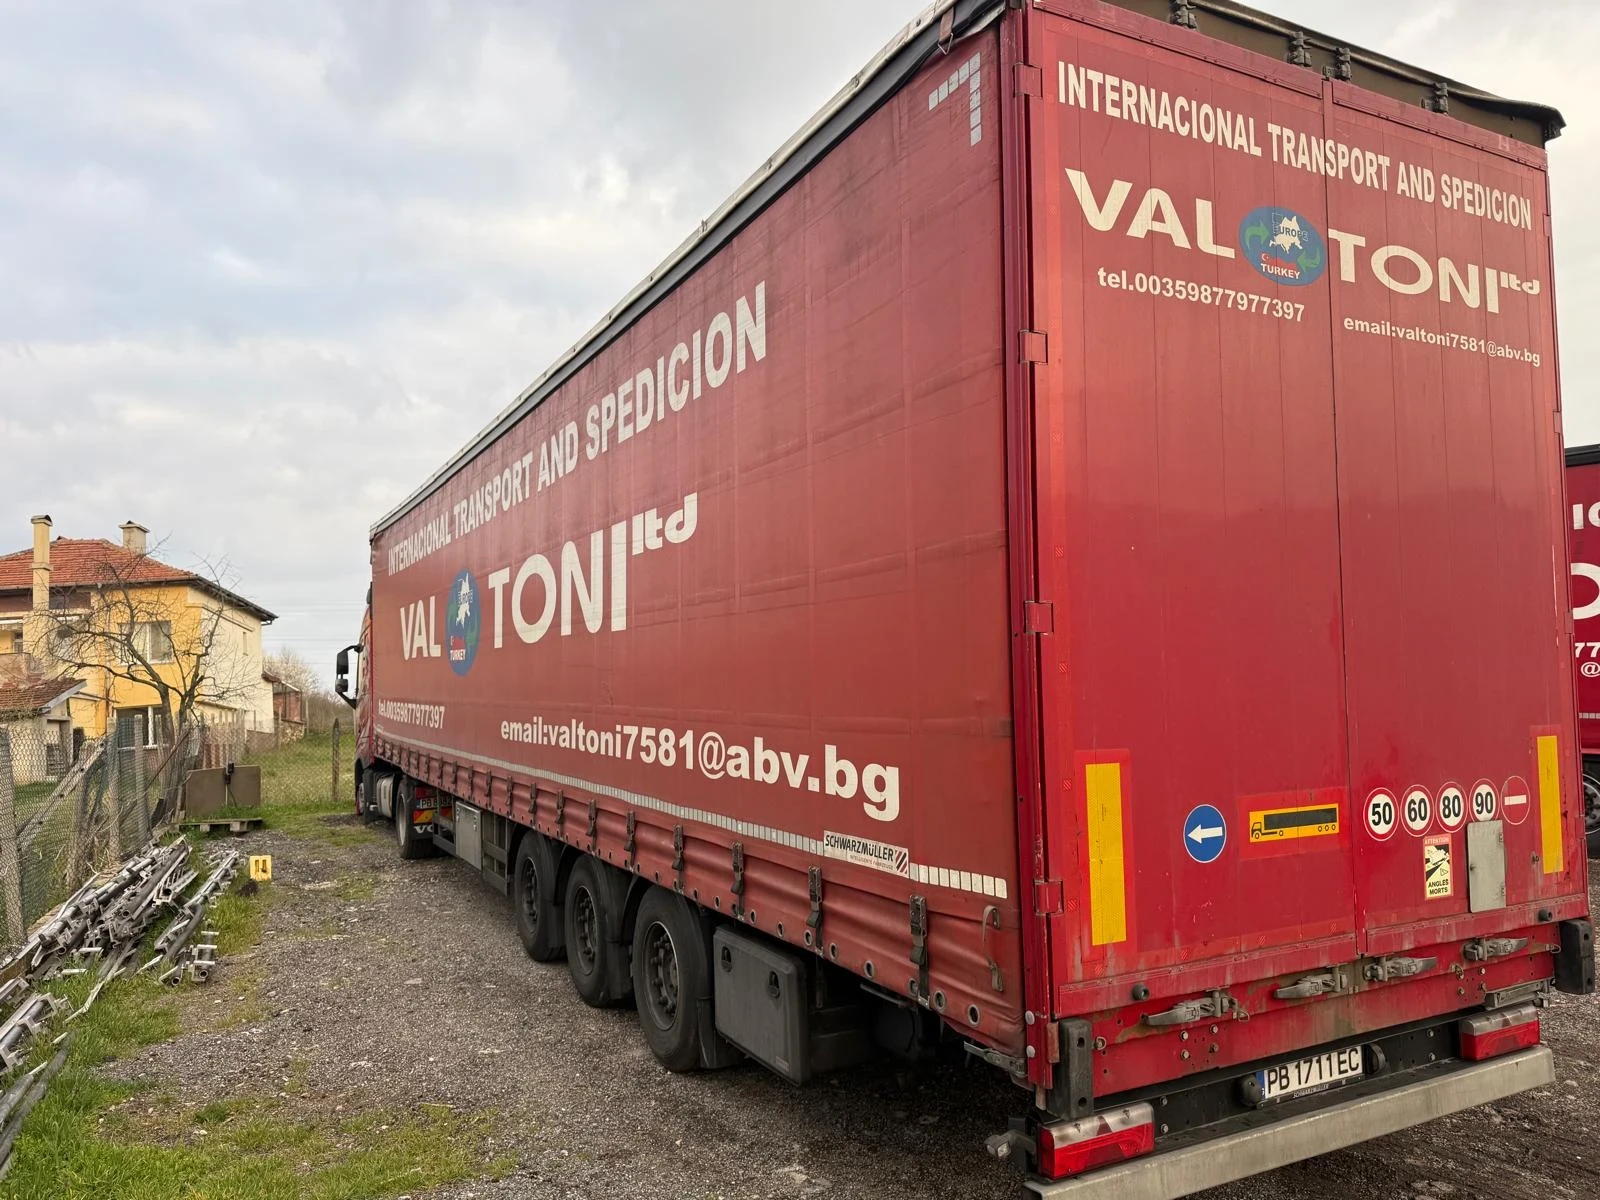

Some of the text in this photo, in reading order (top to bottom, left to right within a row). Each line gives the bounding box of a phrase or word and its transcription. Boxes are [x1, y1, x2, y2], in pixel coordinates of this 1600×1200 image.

[1058, 61, 1532, 231] INTERNACIONAL TRANSPORT AND SPEDICION
[1065, 167, 1235, 259] VAL
[1329, 228, 1500, 313] TONI
[1260, 263, 1300, 280] TURKEY
[1098, 266, 1305, 322] tel.00359877977397
[1343, 316, 1541, 367] email:valtoni7581@abv.bg
[388, 280, 767, 577] INTERNACIONAL TRANSPORT AND SPEDICION
[400, 595, 442, 660] VAL
[488, 519, 628, 650] TONI
[500, 716, 901, 822] email:valtoni7581@abv.bg
[1371, 801, 1393, 826] 50
[1407, 797, 1428, 822] 60
[1442, 794, 1461, 819] 80
[1475, 791, 1494, 815] 90
[1428, 879, 1449, 888] ANGLES
[1429, 887, 1448, 895] MORTS
[1267, 1066, 1290, 1094] PB
